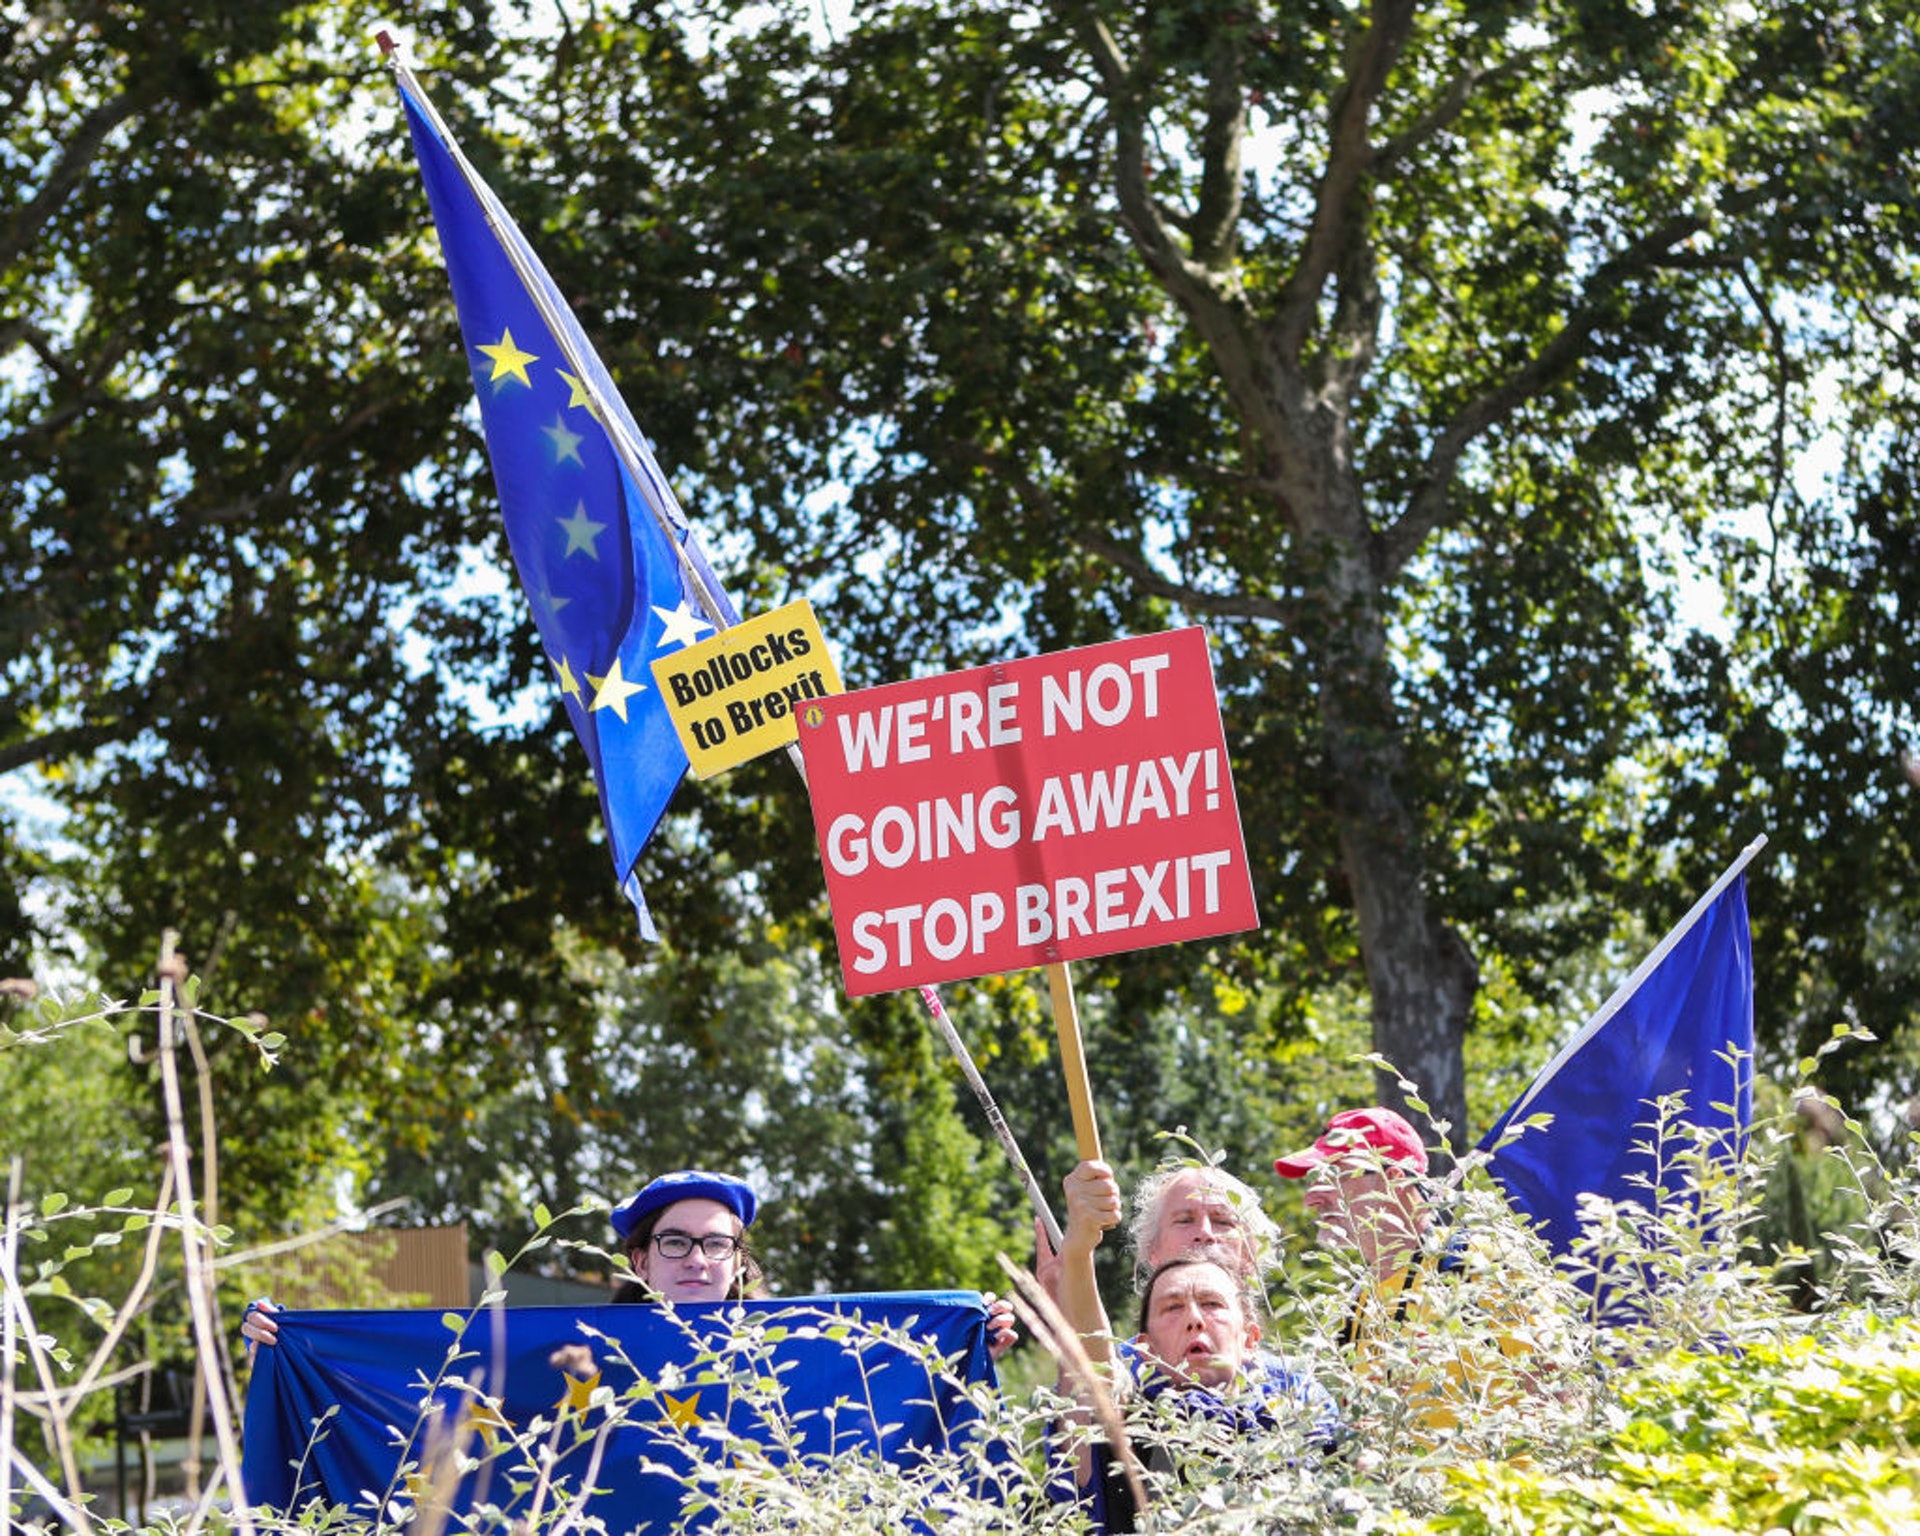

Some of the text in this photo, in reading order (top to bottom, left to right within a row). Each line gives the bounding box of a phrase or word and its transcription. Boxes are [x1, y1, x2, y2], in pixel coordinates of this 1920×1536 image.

[668, 628, 811, 708] Bollocks
[690, 671, 827, 751] to Brexit
[837, 653, 1170, 774] WE'RE NOT
[826, 747, 1219, 877] GOING AWAY!
[851, 850, 1232, 975] STOP BREXIT
